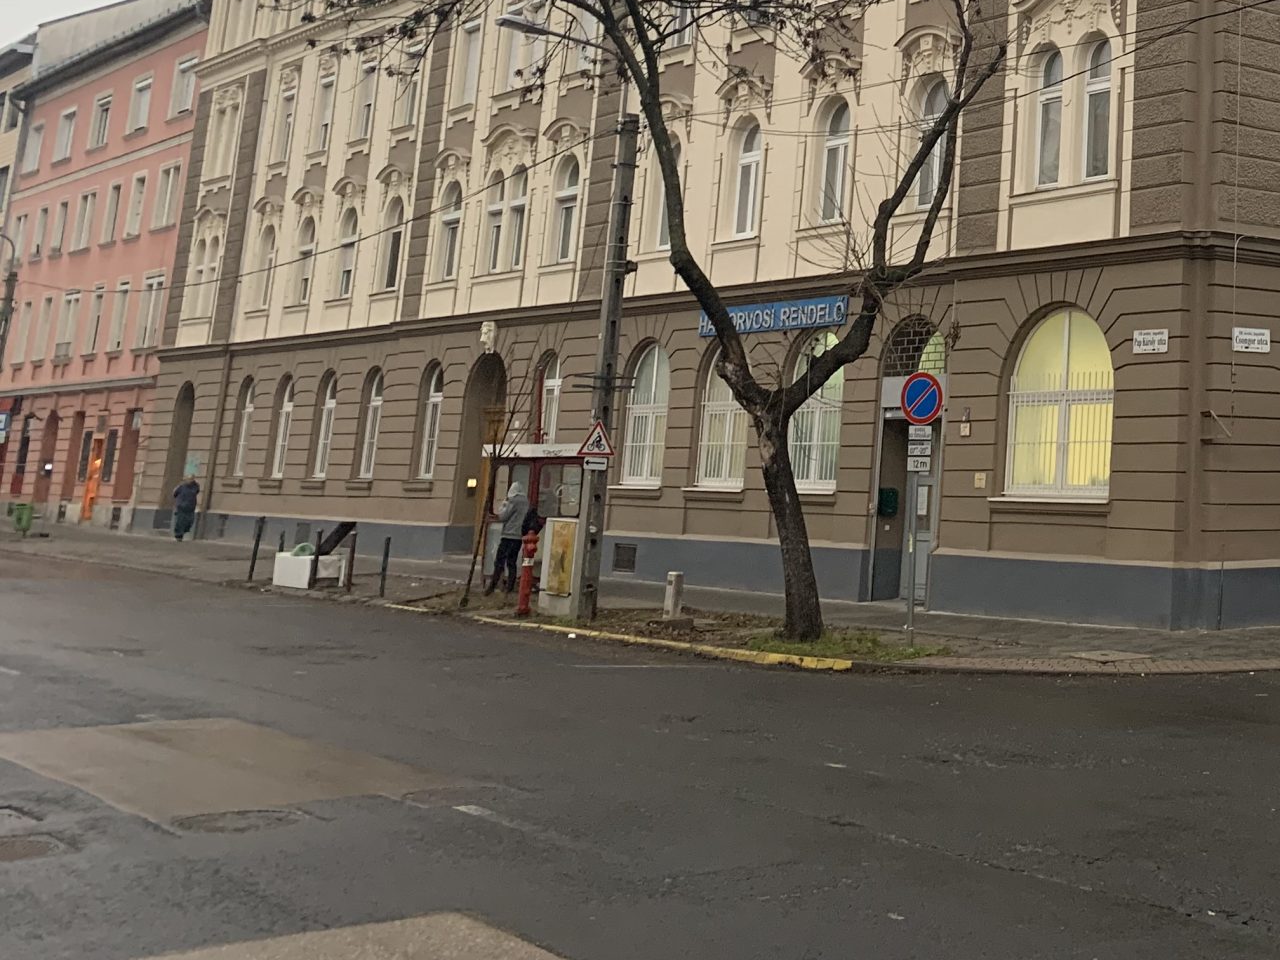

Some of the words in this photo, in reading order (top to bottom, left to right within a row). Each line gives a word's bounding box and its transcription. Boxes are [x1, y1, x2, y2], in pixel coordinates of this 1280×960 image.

[780, 297, 845, 327] RENDELŐ
[1235, 335, 1256, 346] Csongor
[1257, 336, 1269, 346] utca
